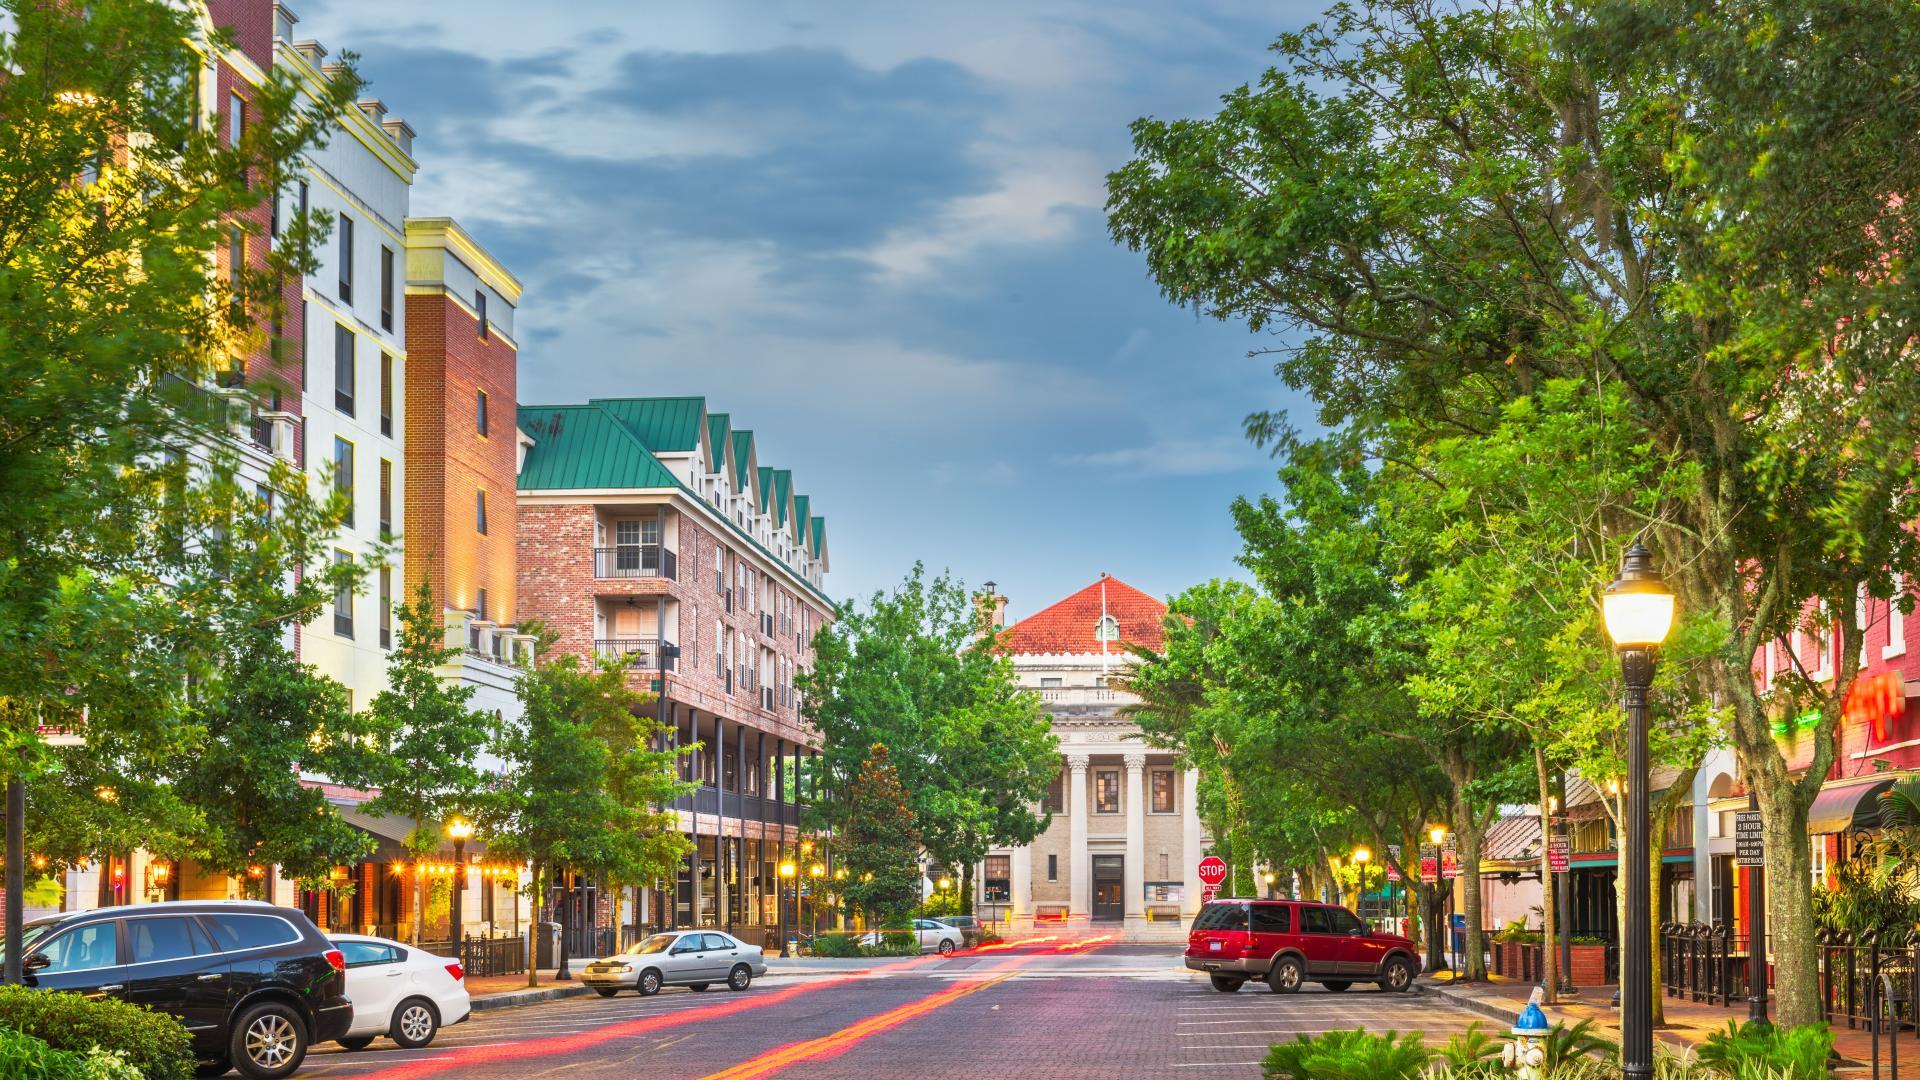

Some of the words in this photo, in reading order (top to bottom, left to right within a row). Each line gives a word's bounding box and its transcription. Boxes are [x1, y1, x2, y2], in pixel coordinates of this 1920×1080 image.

[1743, 822, 1761, 830] HOUR
[1736, 831, 1748, 839] TIME
[1200, 865, 1224, 876] STOP
